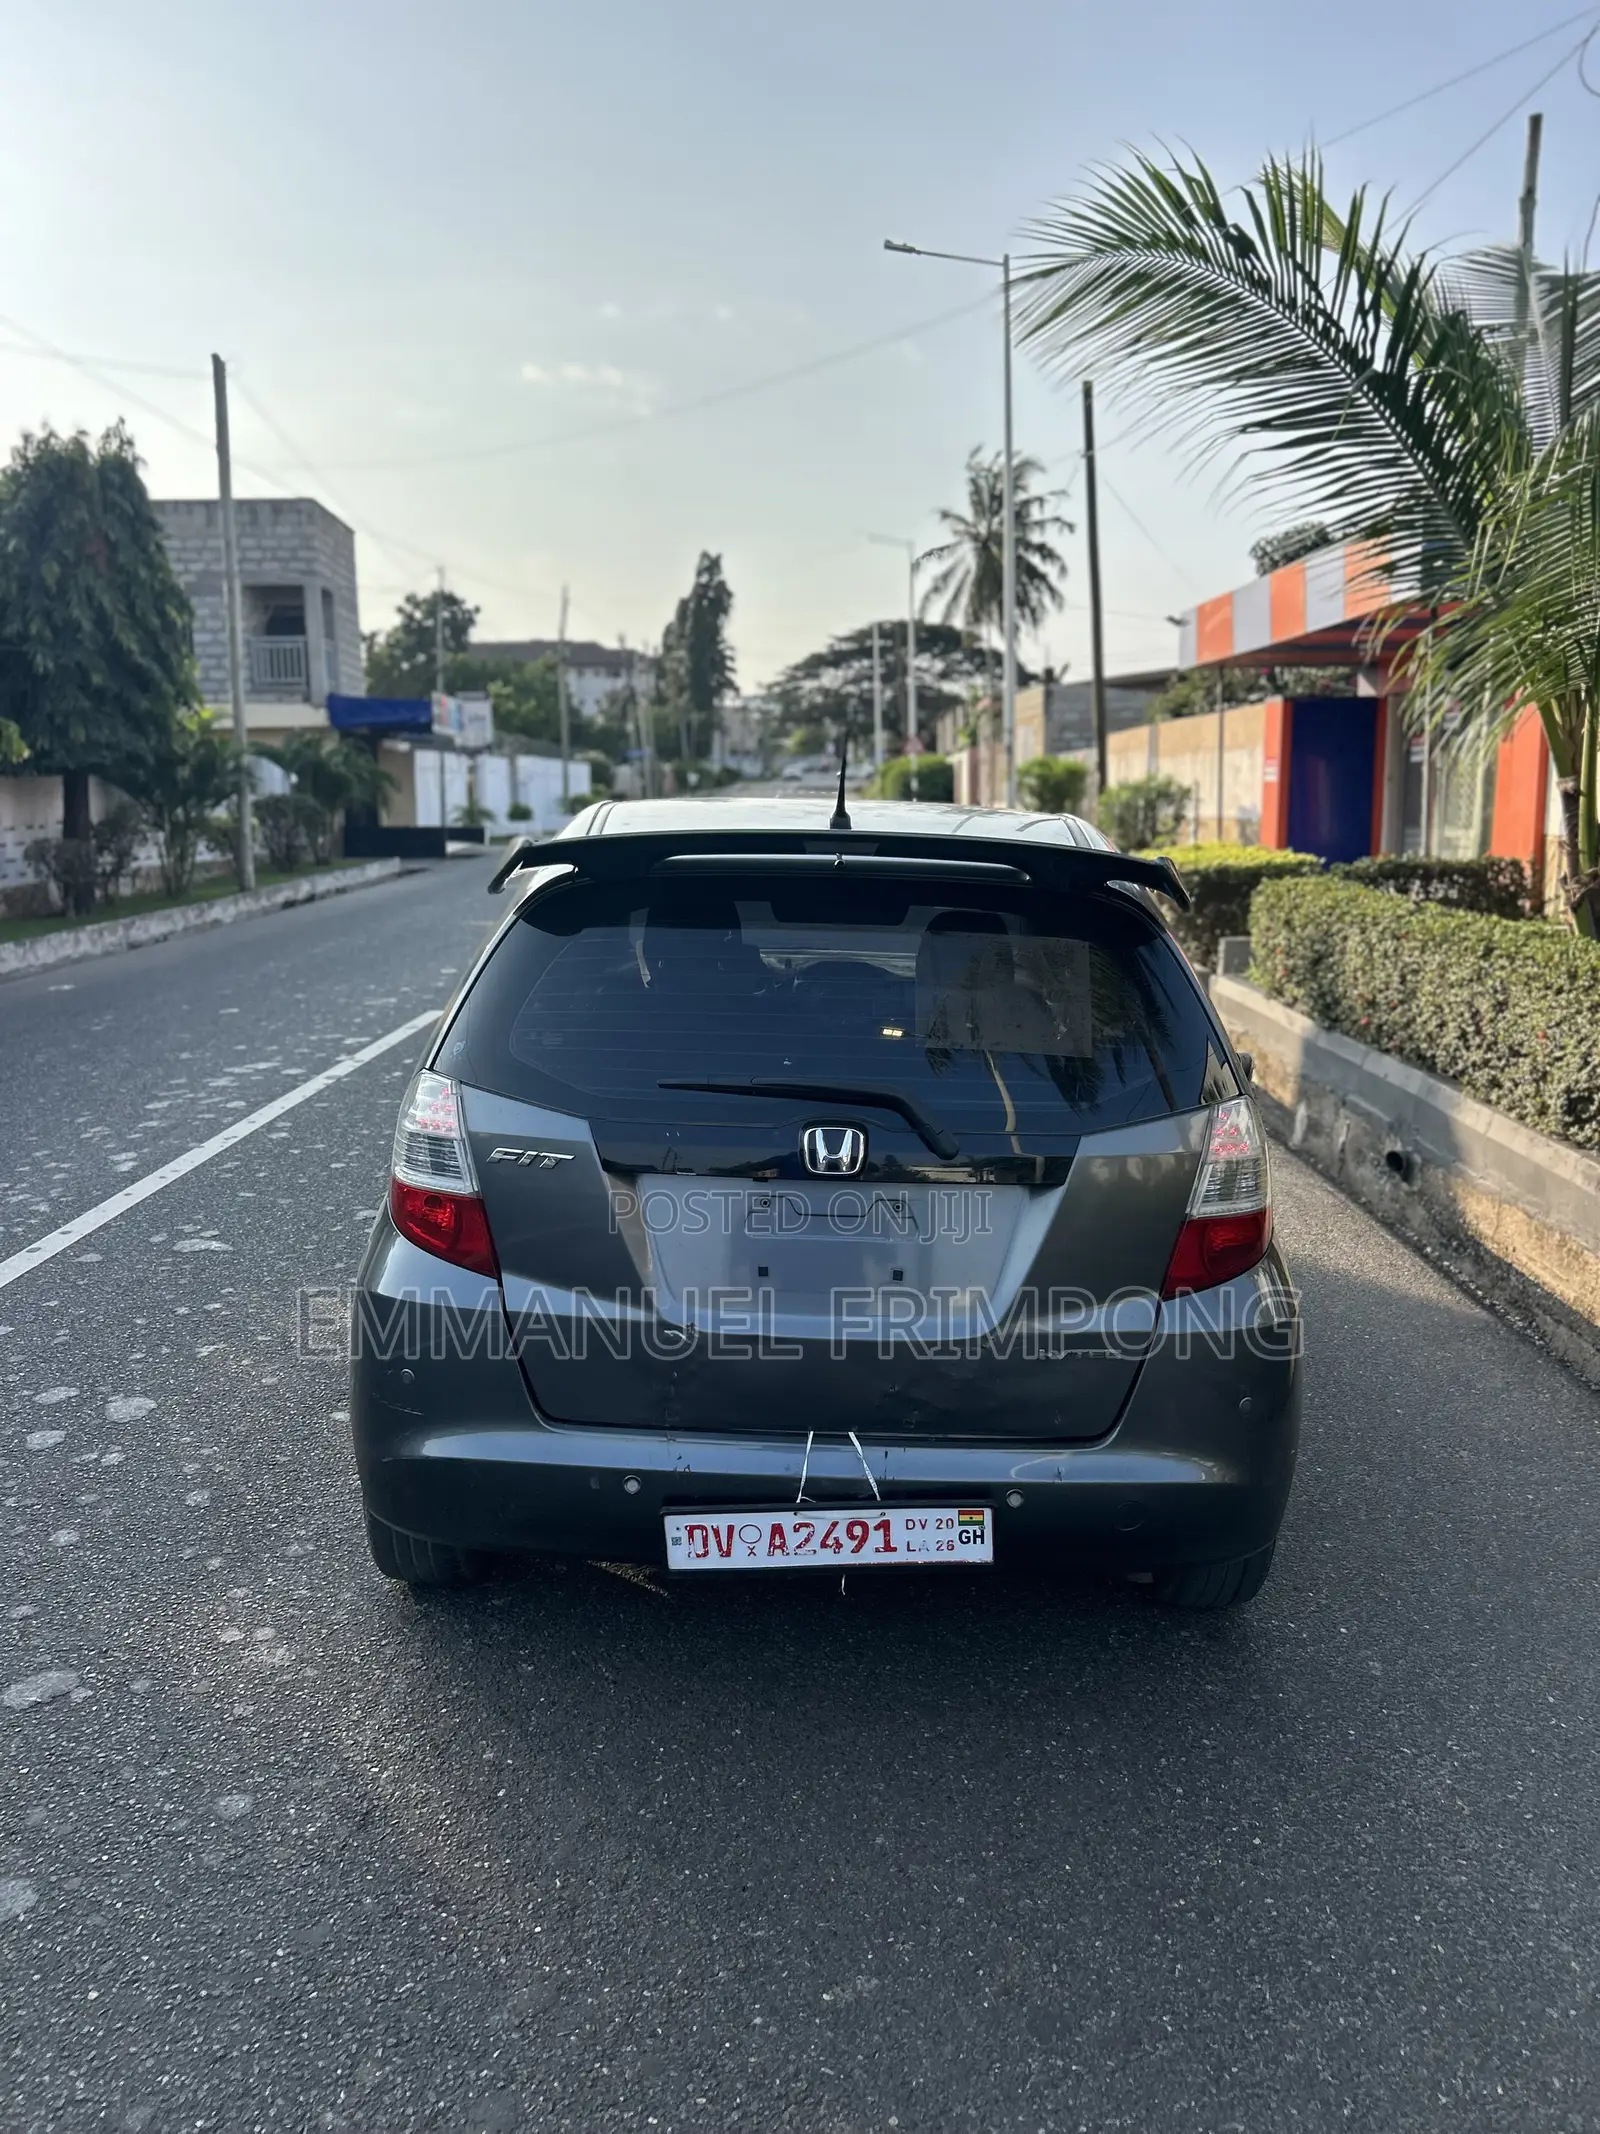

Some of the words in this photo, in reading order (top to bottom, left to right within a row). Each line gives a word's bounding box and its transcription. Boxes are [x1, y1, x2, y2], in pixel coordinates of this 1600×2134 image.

[486, 1147, 576, 1169] FIT
[905, 1518, 928, 1531] DV
[935, 1517, 955, 1530] 20
[684, 1524, 735, 1558] DV
[767, 1519, 897, 1556] A2491
[958, 1529, 985, 1545] GH
